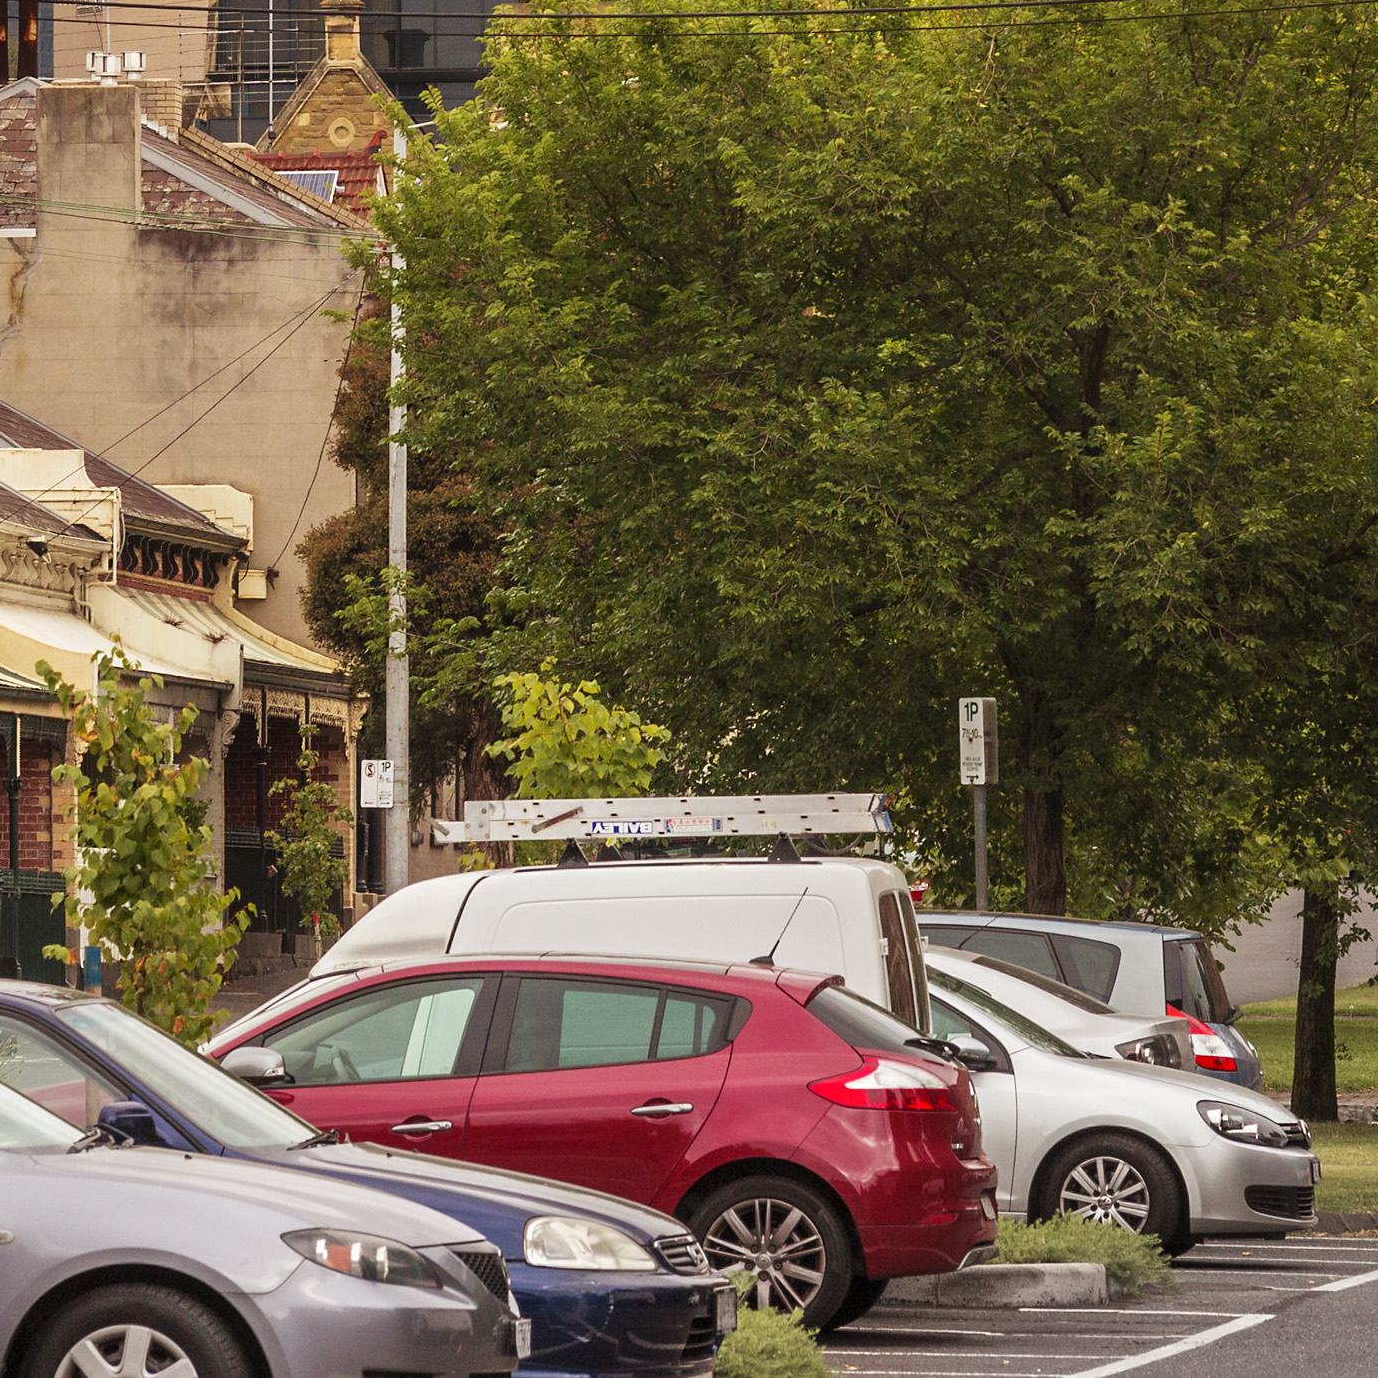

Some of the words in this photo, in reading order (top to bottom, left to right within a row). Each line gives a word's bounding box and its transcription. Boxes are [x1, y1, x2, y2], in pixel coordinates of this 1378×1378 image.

[964, 702, 979, 722] 1P
[381, 762, 391, 773] 1P
[593, 821, 651, 834] BAILEY
